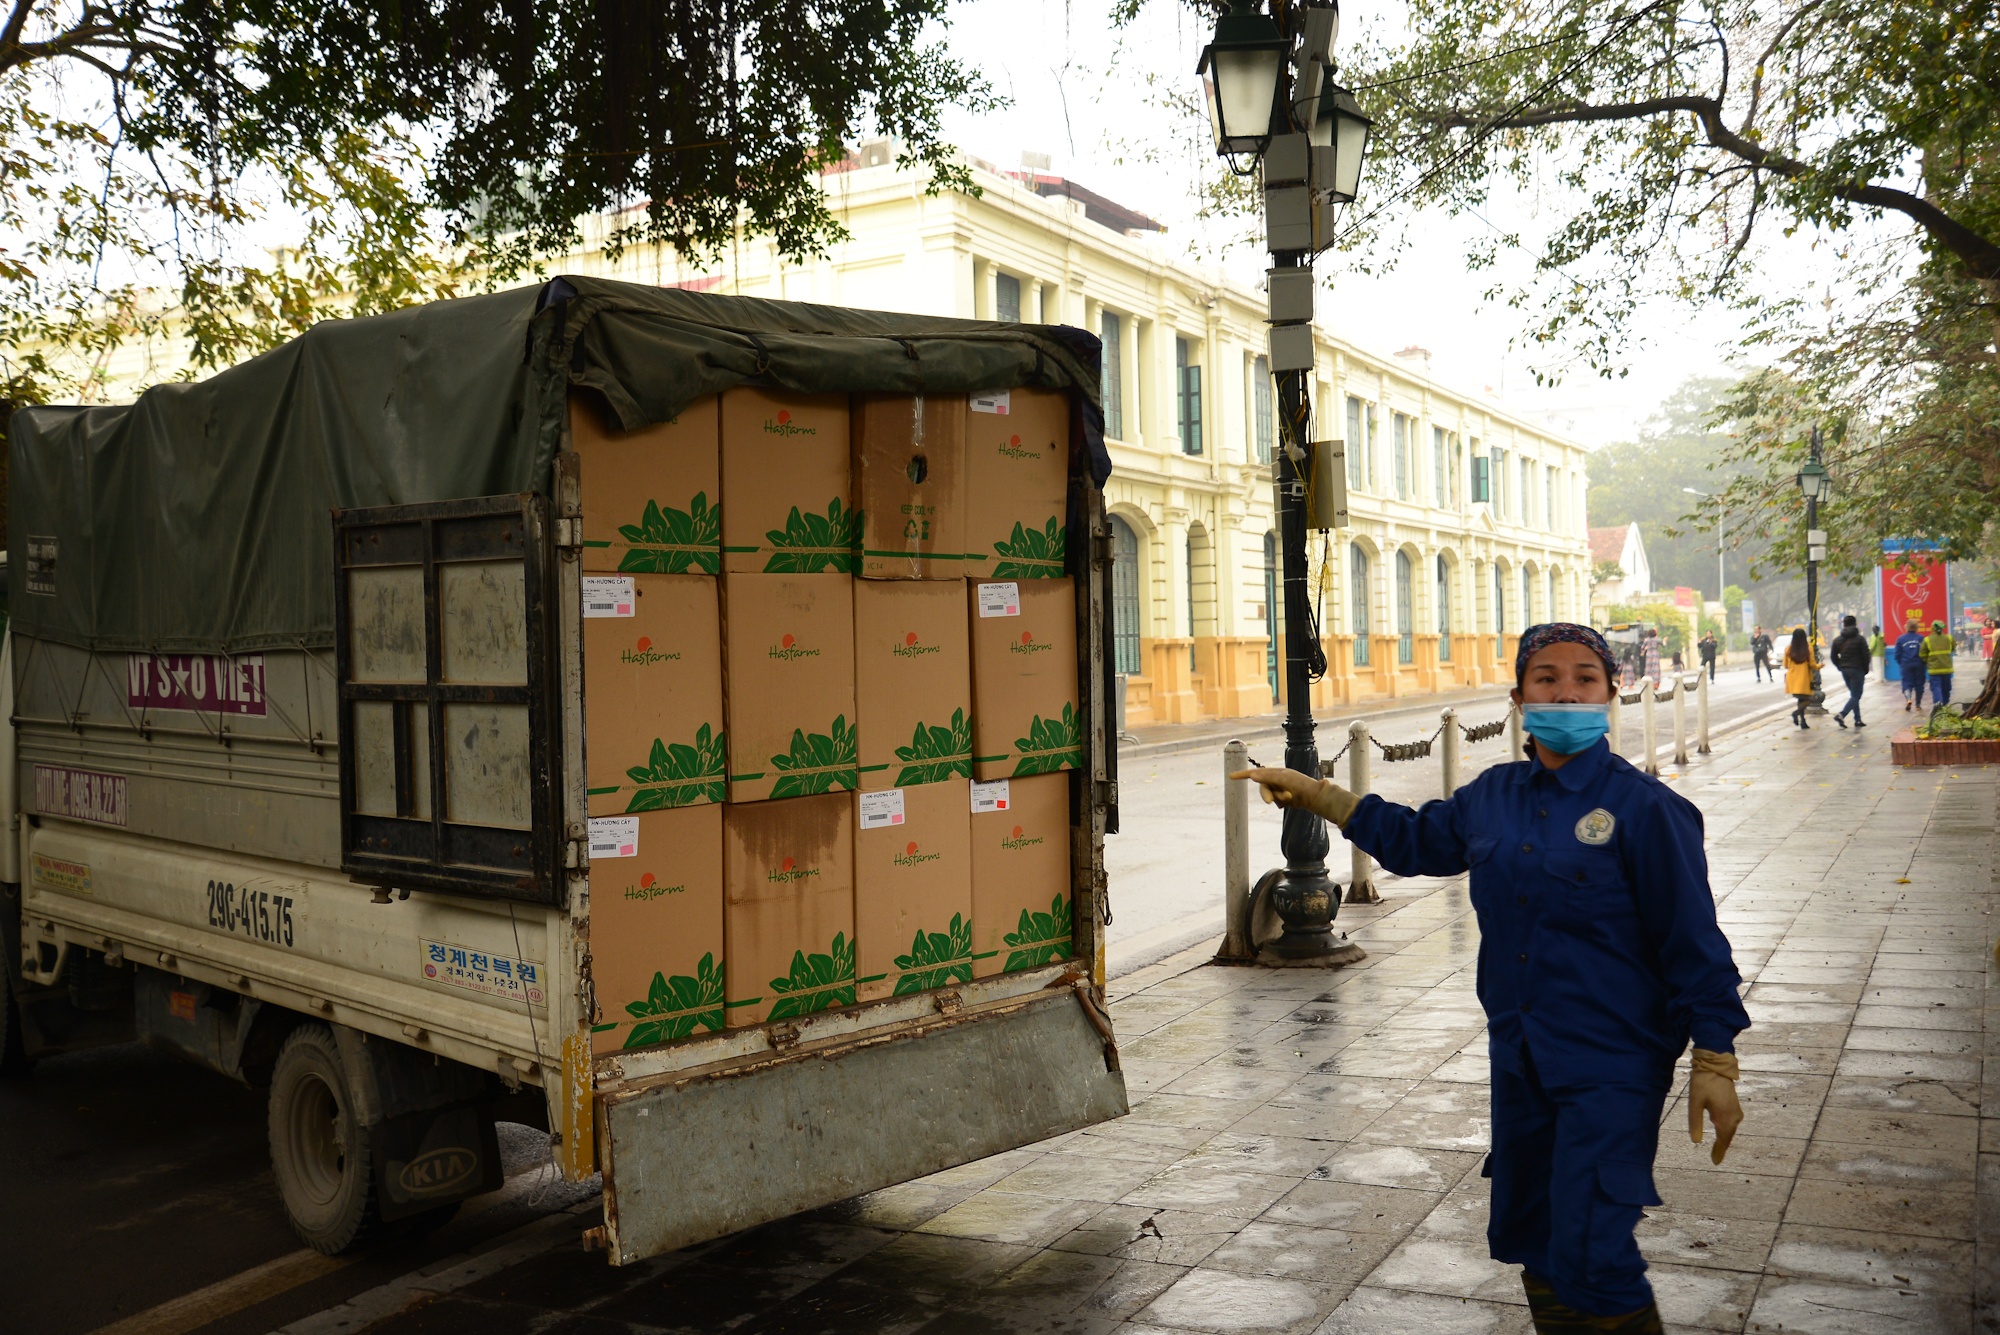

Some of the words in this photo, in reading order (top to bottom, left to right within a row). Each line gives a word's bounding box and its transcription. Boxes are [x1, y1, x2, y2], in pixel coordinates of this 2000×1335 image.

[764, 419, 816, 437] Hasfarm
[999, 442, 1040, 460] Hasfarm
[1906, 609, 1923, 619] 90
[621, 647, 680, 665] Hasfarm
[769, 644, 820, 661] Hasfarm
[893, 642, 940, 658] Hasfarm
[1010, 640, 1052, 655] Hasfarm
[1002, 834, 1043, 850] Hasfarm
[894, 850, 940, 867] Hasfarm
[768, 866, 820, 883] Hasfarm
[624, 882, 684, 900] Hasfarm
[207, 880, 294, 947] 29C-415.75
[530, 991, 542, 1000] KIA
[413, 1154, 465, 1186] KIA
